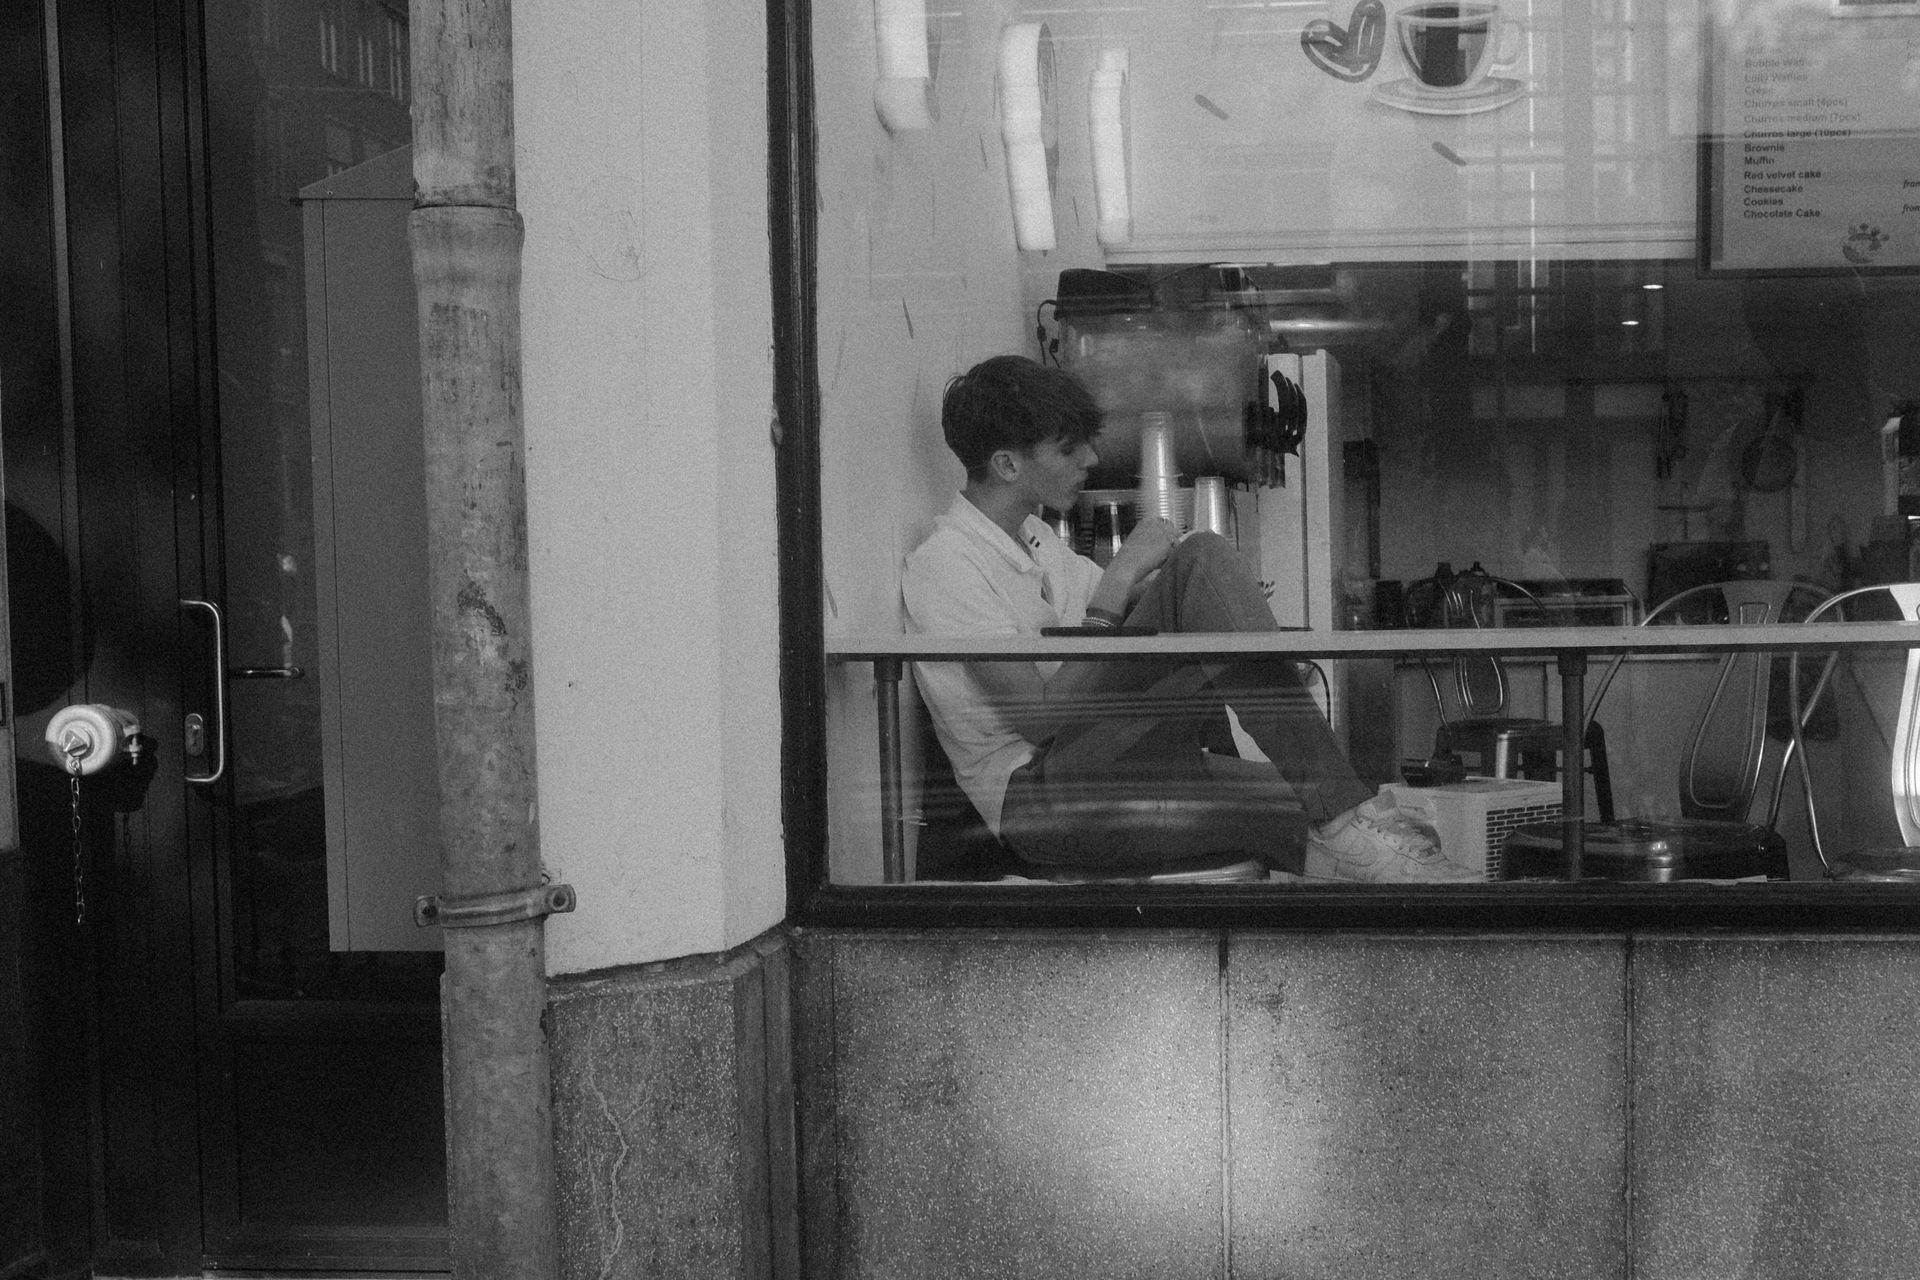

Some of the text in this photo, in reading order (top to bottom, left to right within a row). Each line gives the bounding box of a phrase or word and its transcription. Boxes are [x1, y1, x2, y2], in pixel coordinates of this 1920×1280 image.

[1744, 99, 1785, 109] Churros
[1788, 97, 1814, 108] small
[1744, 114, 1784, 124] Churros
[1787, 111, 1828, 122] medium
[1744, 129, 1784, 139] Churros
[1786, 129, 1812, 139] large
[1744, 143, 1785, 153] Brownie
[1744, 156, 1775, 165] Muffin
[1744, 169, 1822, 180] Red velvet cake
[1743, 184, 1803, 194] Cheesecake
[1743, 197, 1784, 206] Cookies
[1743, 207, 1821, 219] Chocolate Cake
